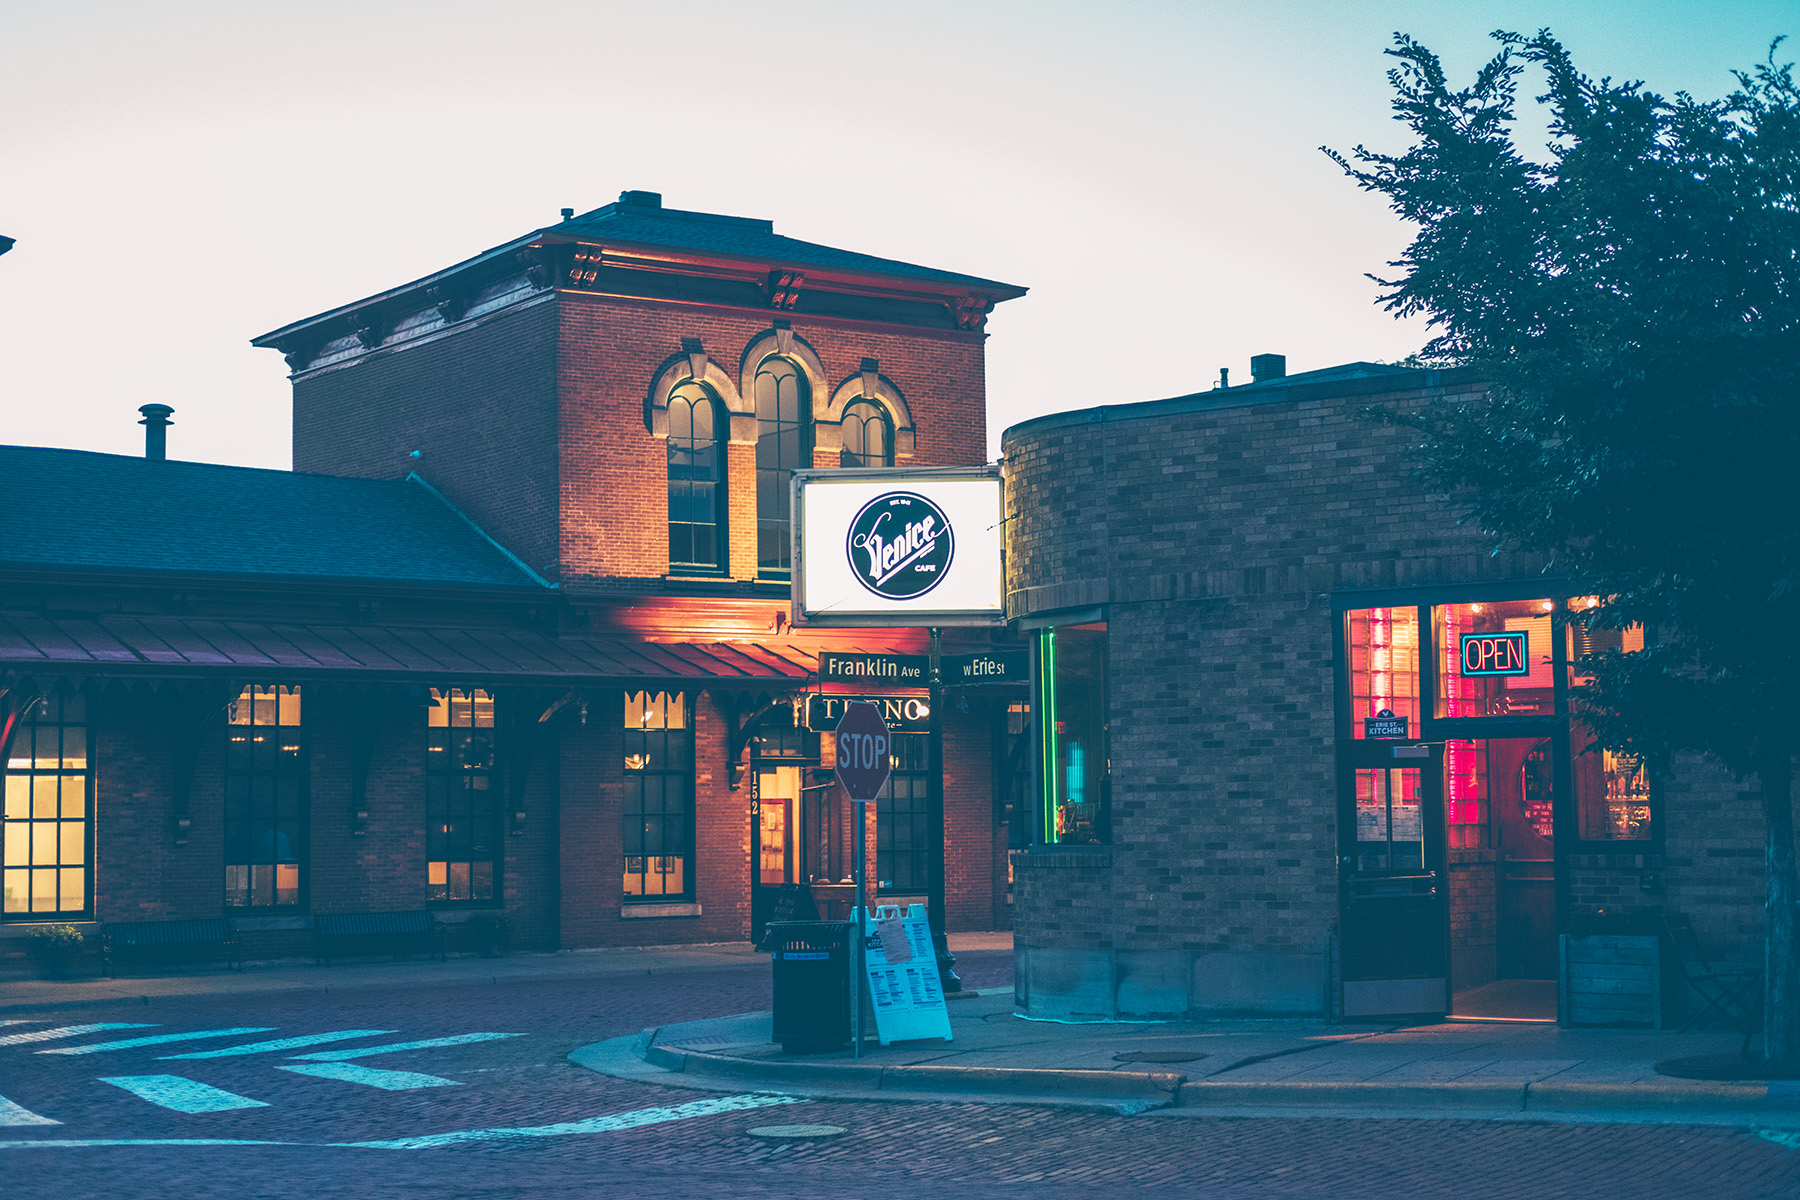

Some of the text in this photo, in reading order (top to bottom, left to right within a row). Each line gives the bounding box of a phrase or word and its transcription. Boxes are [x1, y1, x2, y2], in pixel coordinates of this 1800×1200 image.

[854, 512, 950, 580] Venice
[914, 564, 936, 572] CAFE
[1465, 638, 1522, 670] OPEN
[829, 658, 920, 677] Franklin Ave
[973, 657, 995, 676] Erie
[823, 698, 921, 720] TNO
[1369, 727, 1404, 735] KITCHEN
[840, 732, 886, 770] STOP
